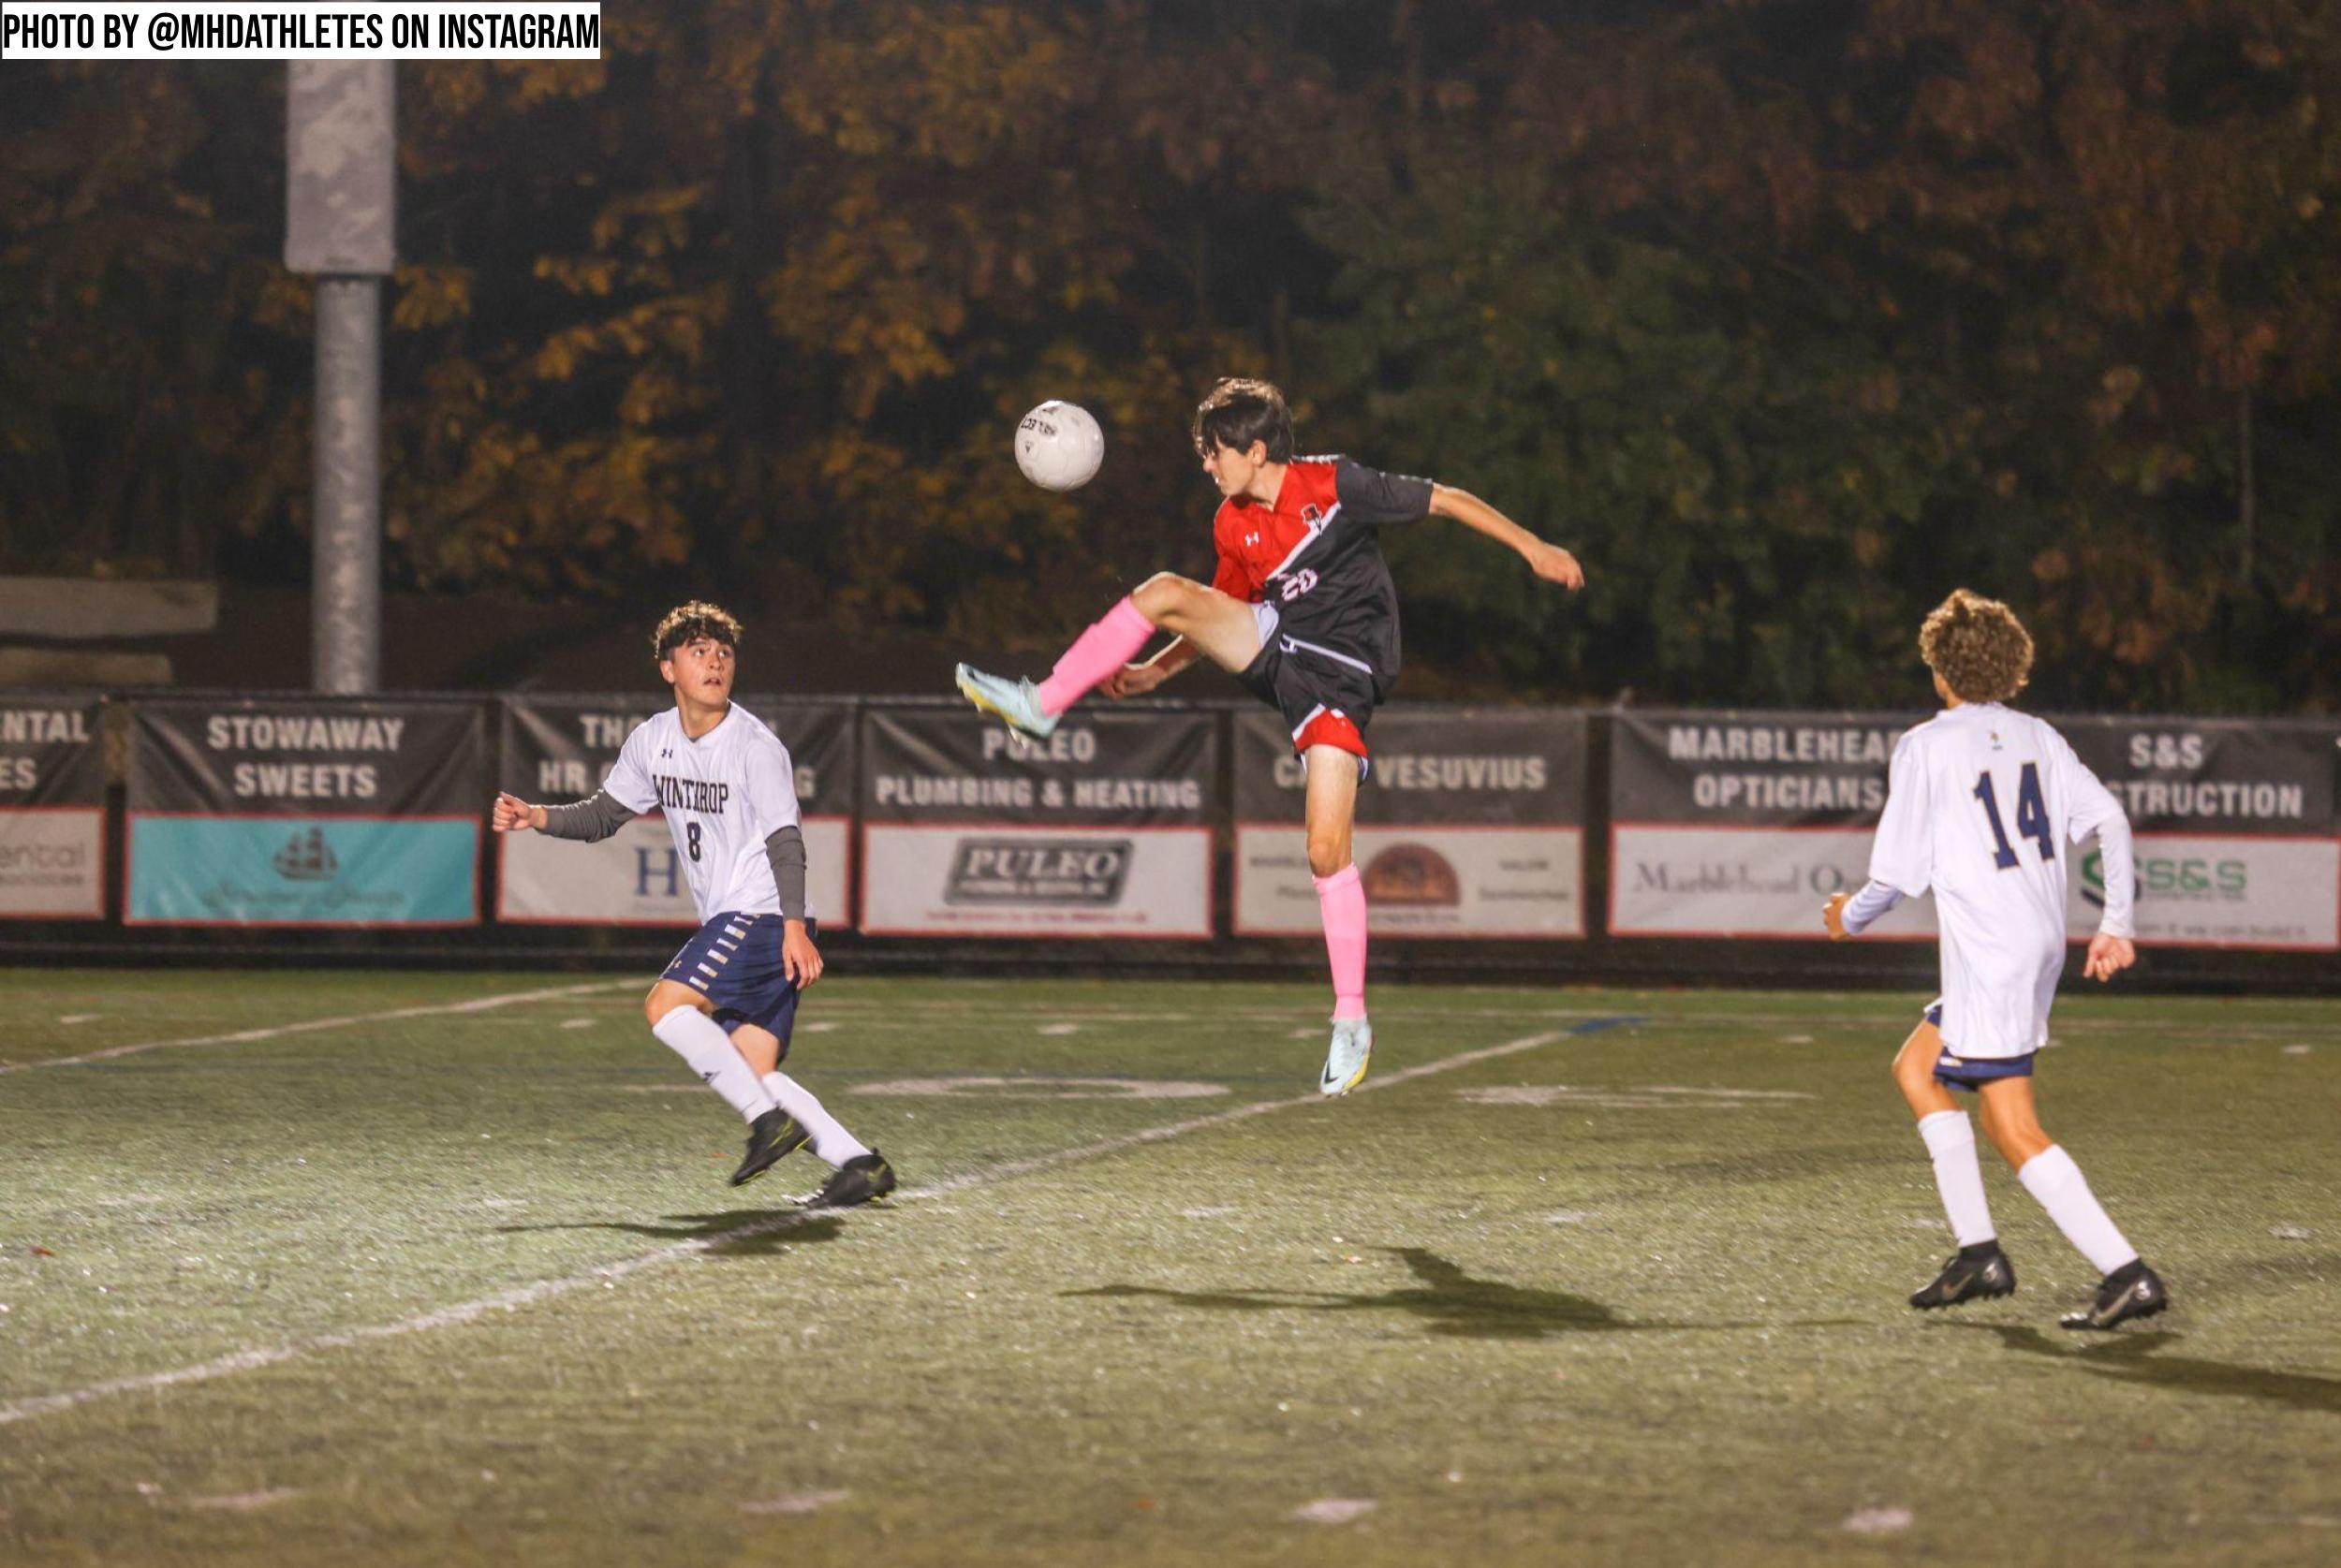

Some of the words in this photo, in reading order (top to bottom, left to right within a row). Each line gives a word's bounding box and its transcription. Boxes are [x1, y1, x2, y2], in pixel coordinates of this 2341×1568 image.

[0, 711, 90, 742] NTAL
[207, 717, 405, 752] STOWAWAY
[2130, 735, 2203, 769] S&S
[234, 764, 378, 799] SWEETS
[1374, 755, 1548, 790] VESUVIUS
[653, 774, 729, 814] WINTHROP
[876, 777, 1031, 808] PLUMBING
[1040, 780, 1064, 807] &
[1074, 781, 1201, 809] HEATING
[1694, 775, 1884, 811] OPTICIANS
[1973, 761, 2056, 871] 14
[686, 822, 701, 862] 8
[967, 849, 1118, 878] PULEO
